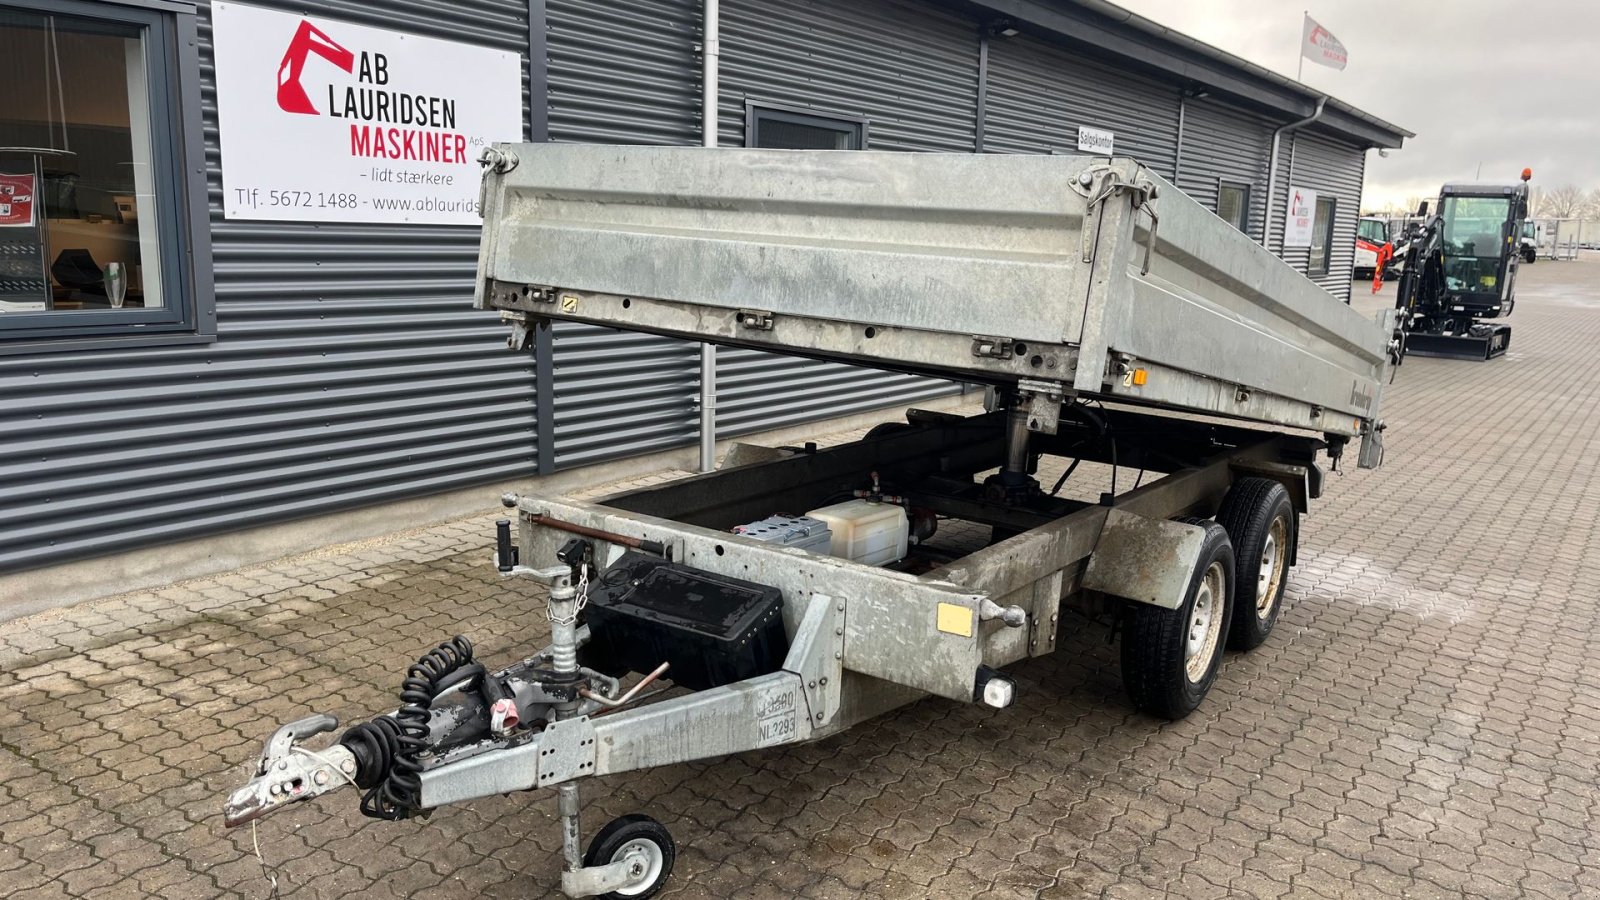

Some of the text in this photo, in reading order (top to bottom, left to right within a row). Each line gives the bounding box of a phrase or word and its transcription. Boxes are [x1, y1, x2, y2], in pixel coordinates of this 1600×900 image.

[358, 50, 389, 86] AB
[328, 84, 456, 130] LAURIDSEN
[350, 123, 485, 165] MASKINER ApS
[1080, 130, 1112, 148] Salgskontor
[371, 167, 393, 183] lidt
[396, 169, 454, 186] stærkere
[234, 188, 264, 209] Tlf.
[269, 190, 313, 207] 5672
[318, 192, 358, 209] 1488
